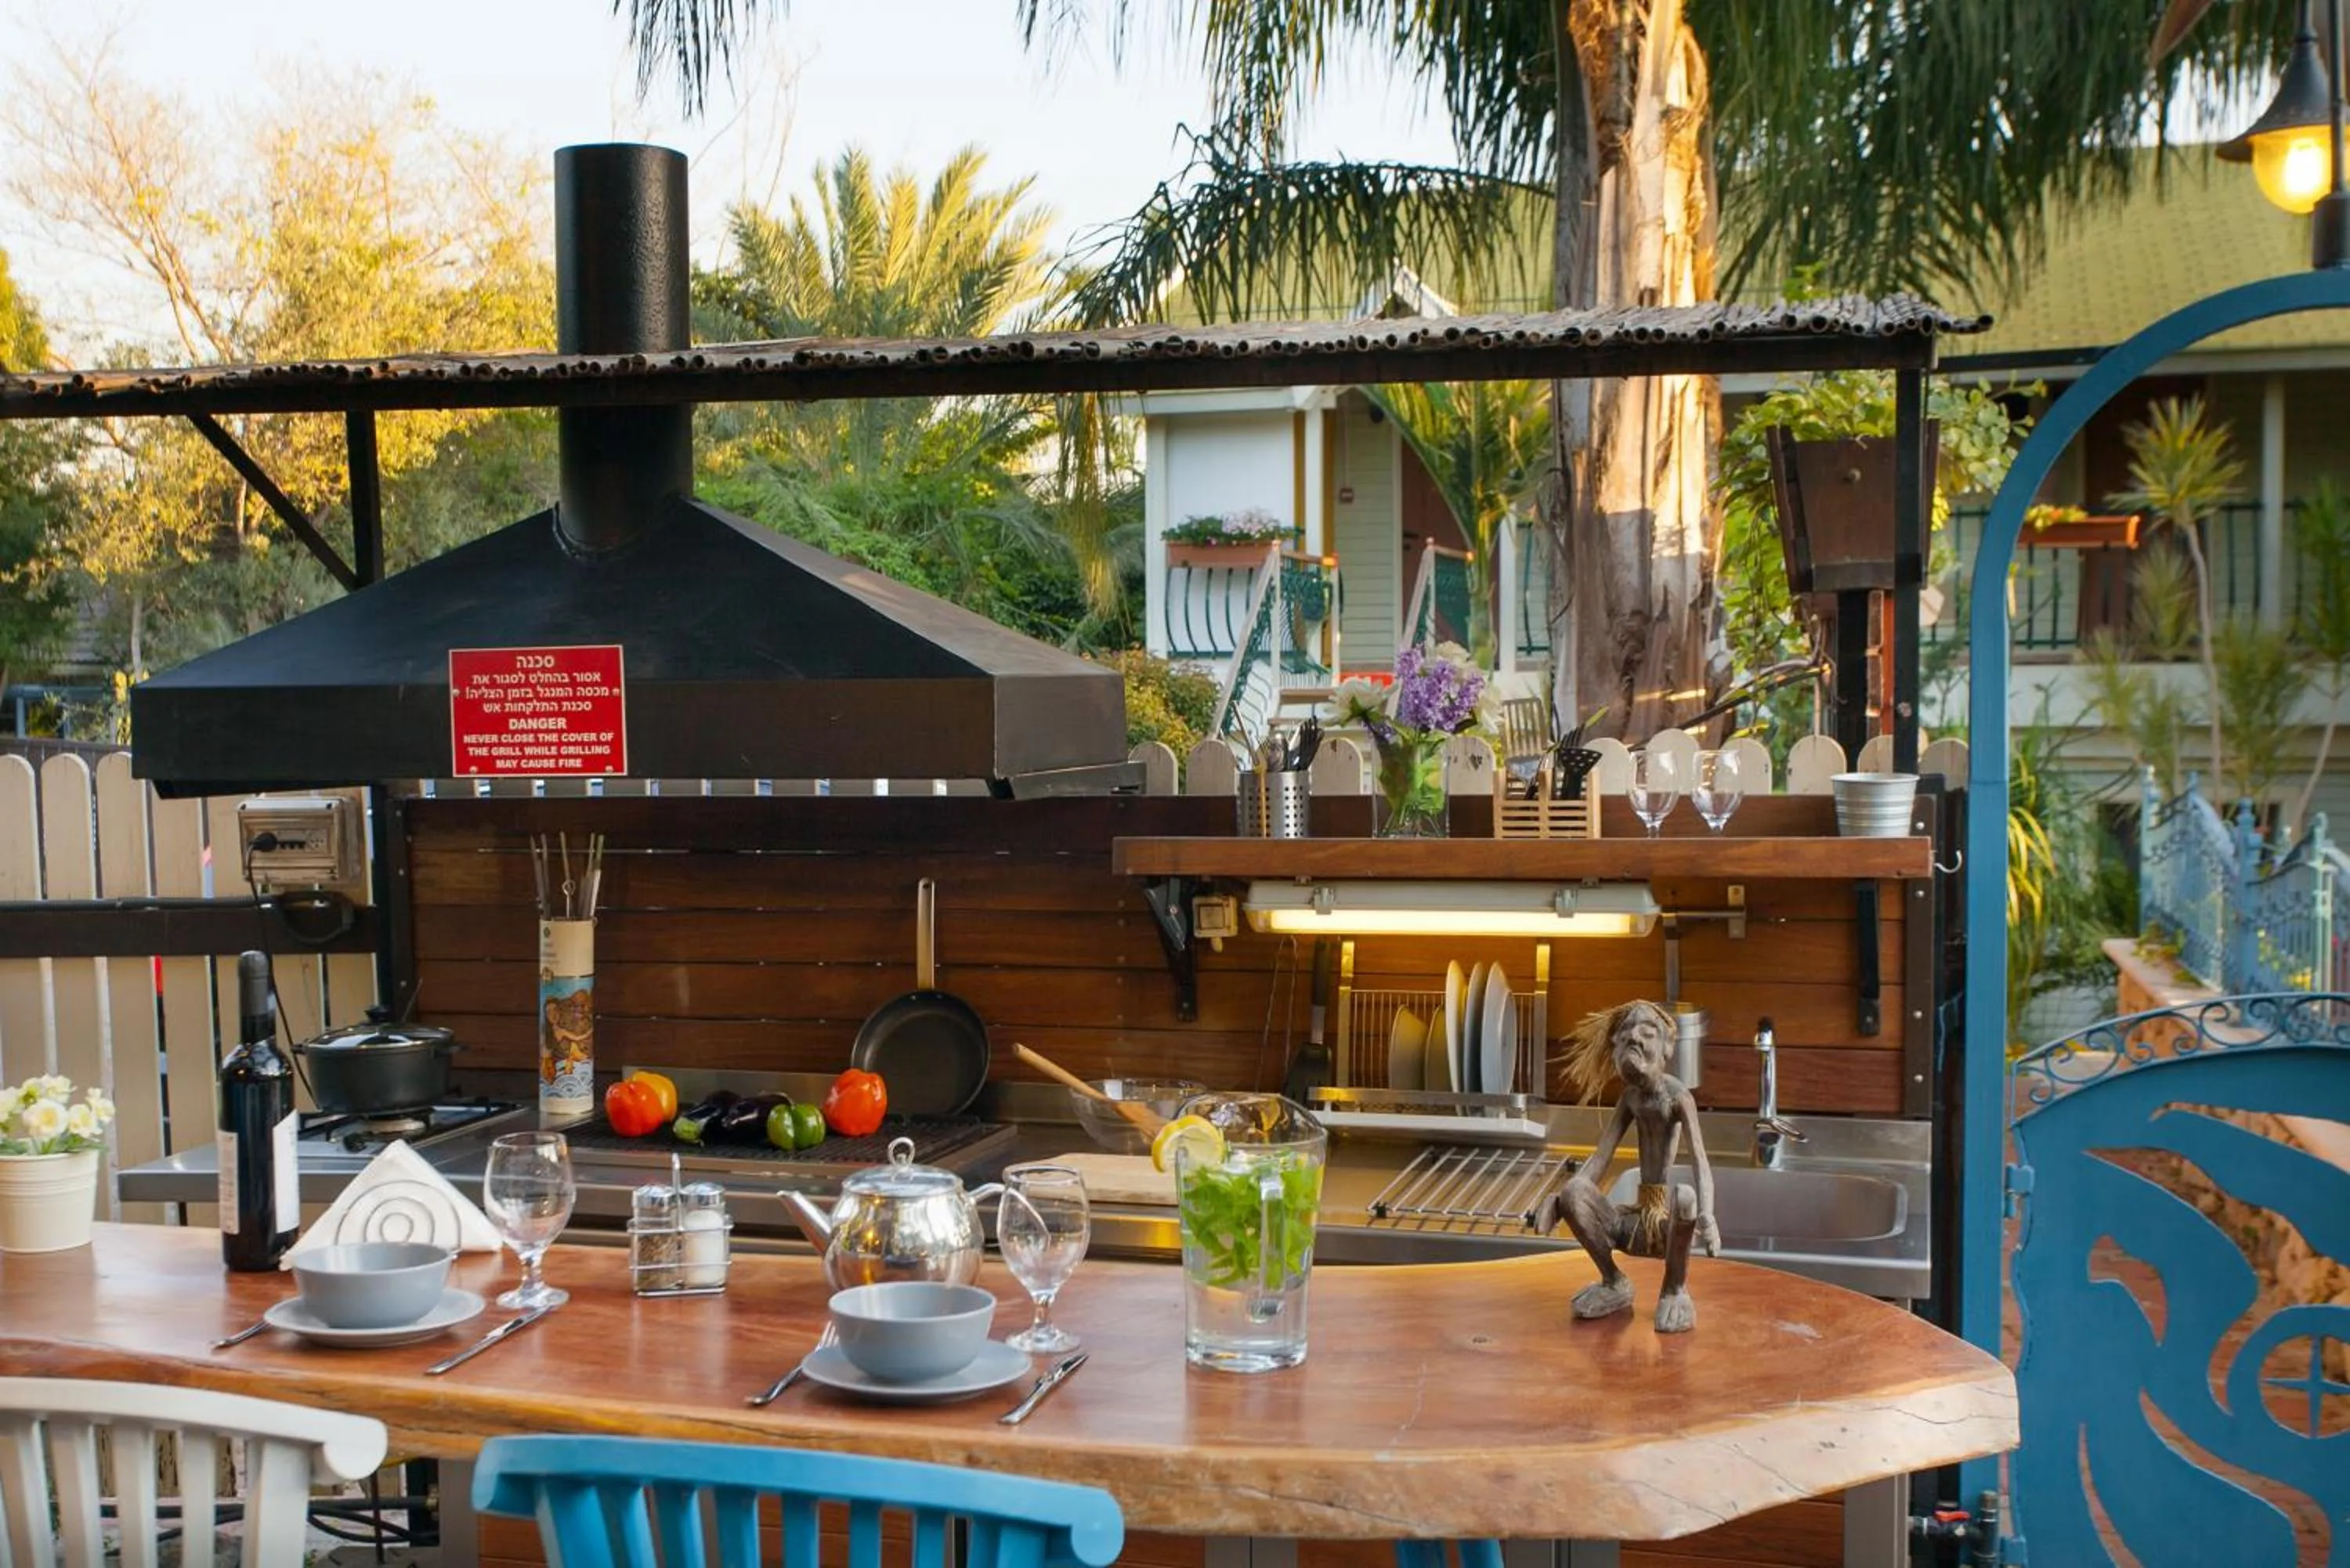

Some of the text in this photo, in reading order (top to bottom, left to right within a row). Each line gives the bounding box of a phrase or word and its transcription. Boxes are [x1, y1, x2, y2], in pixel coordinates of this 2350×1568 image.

[516, 655, 555, 668] סכנה
[472, 670, 601, 685] אסור בהחלט לסגור את
[507, 688, 534, 701] בזמן
[537, 685, 573, 698] המנגל
[576, 686, 609, 696] מכסה
[483, 699, 592, 715] סכנת התלקחות אש
[508, 717, 567, 731] DANGER
[463, 732, 614, 743] NEVER CLOSE THE COVER OF
[468, 745, 611, 756] THE GRILL WHILE GRILLING
[495, 758, 582, 768] MAY CAUSE FIRE
